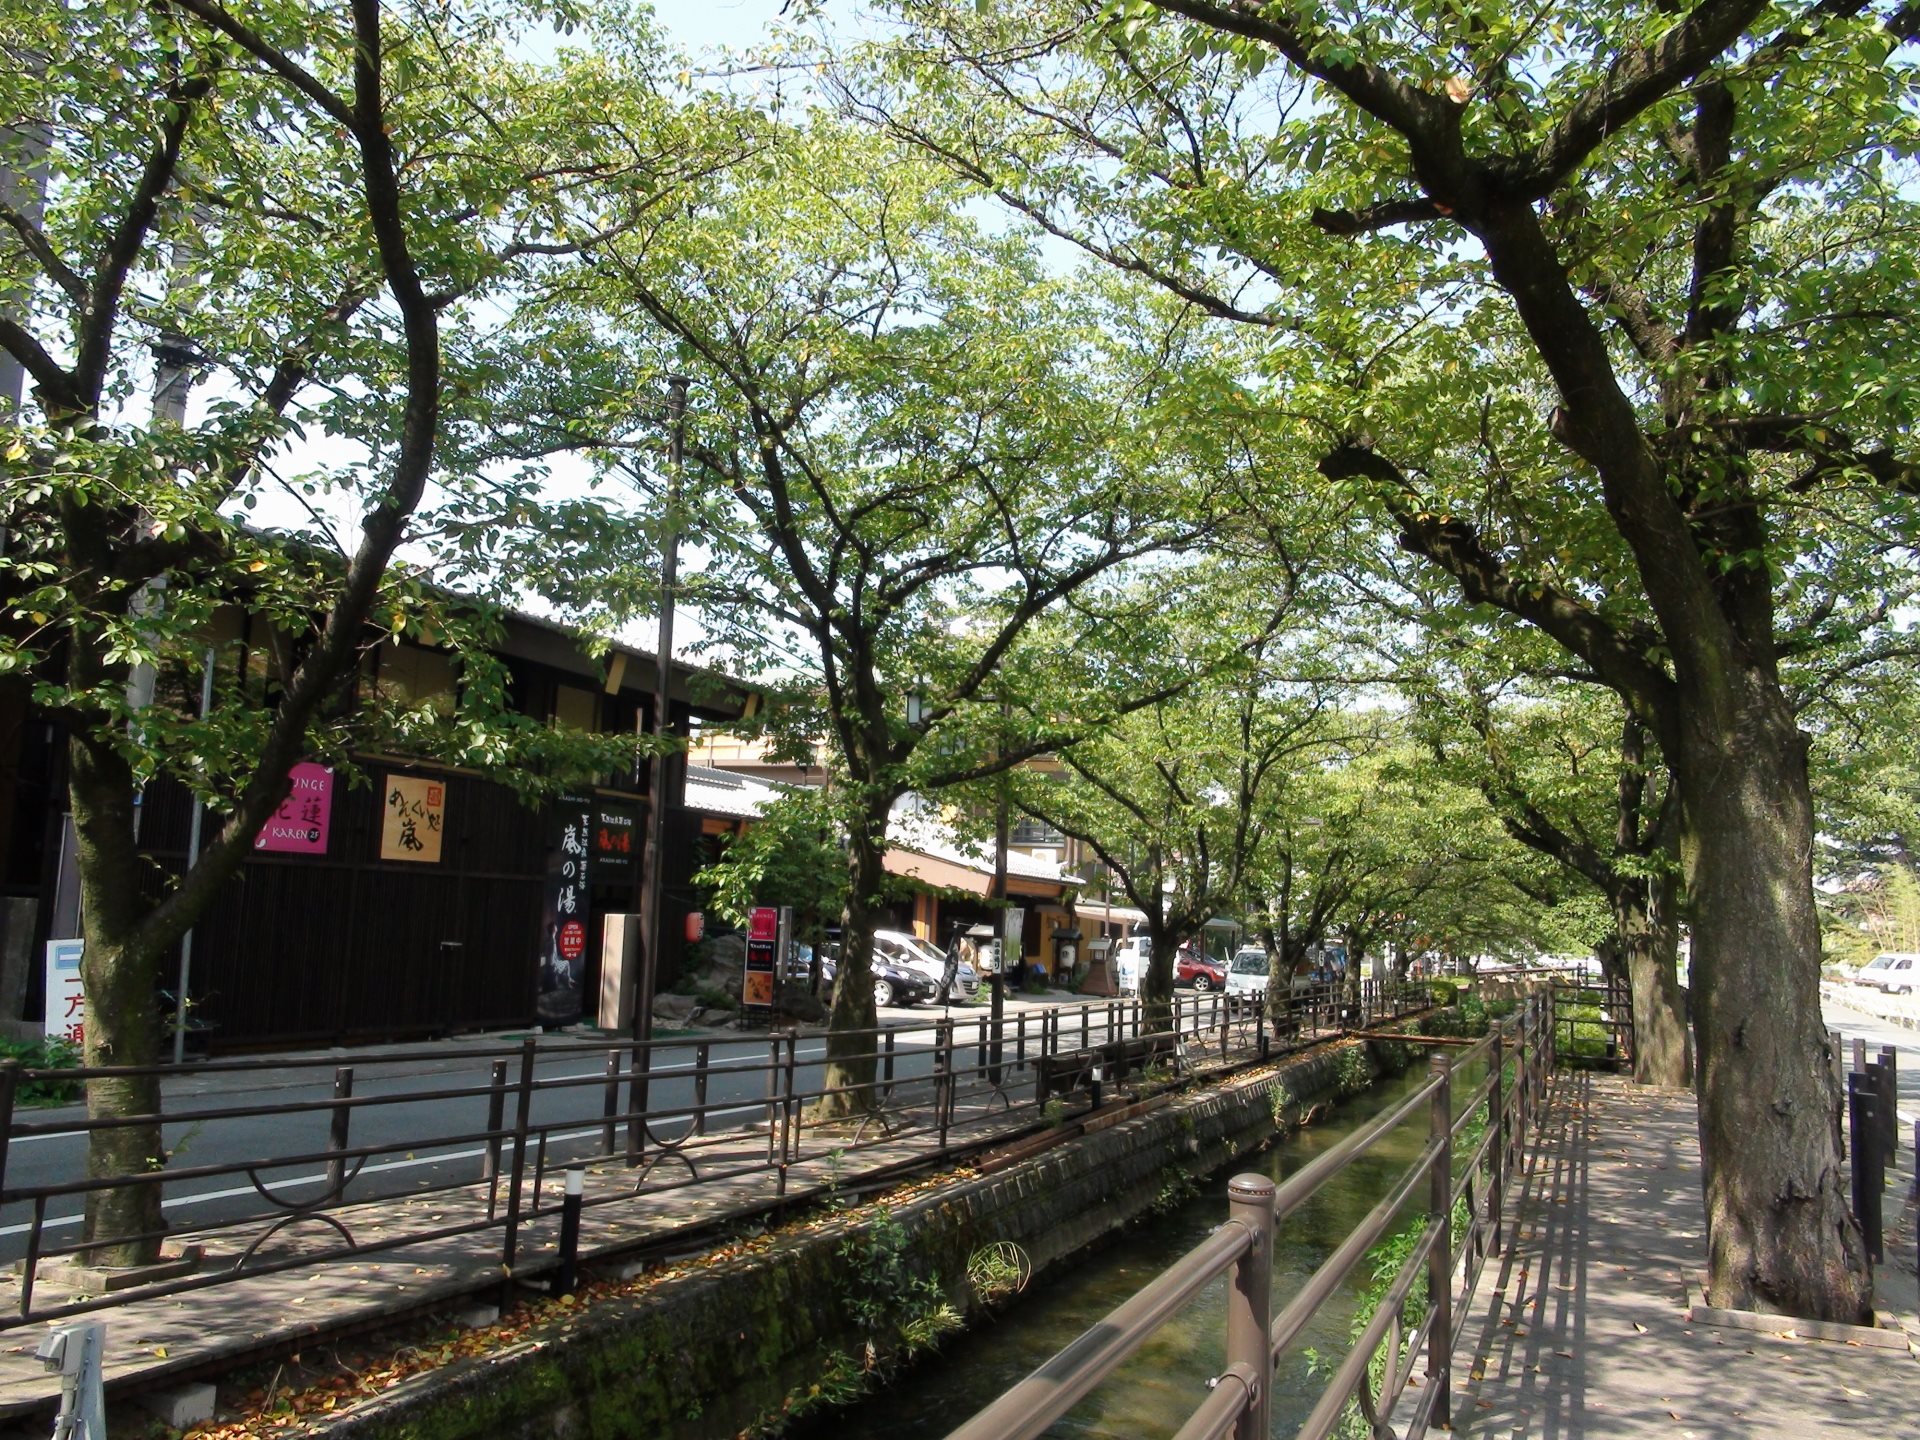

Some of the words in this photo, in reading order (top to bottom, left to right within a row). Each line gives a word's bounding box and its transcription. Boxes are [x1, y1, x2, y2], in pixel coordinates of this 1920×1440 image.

[293, 777, 325, 791] UNGE
[272, 827, 308, 840] KAREN
[309, 830, 320, 840] 2F
[398, 818, 424, 851] 嵐
[557, 824, 582, 914] 嵐の湯
